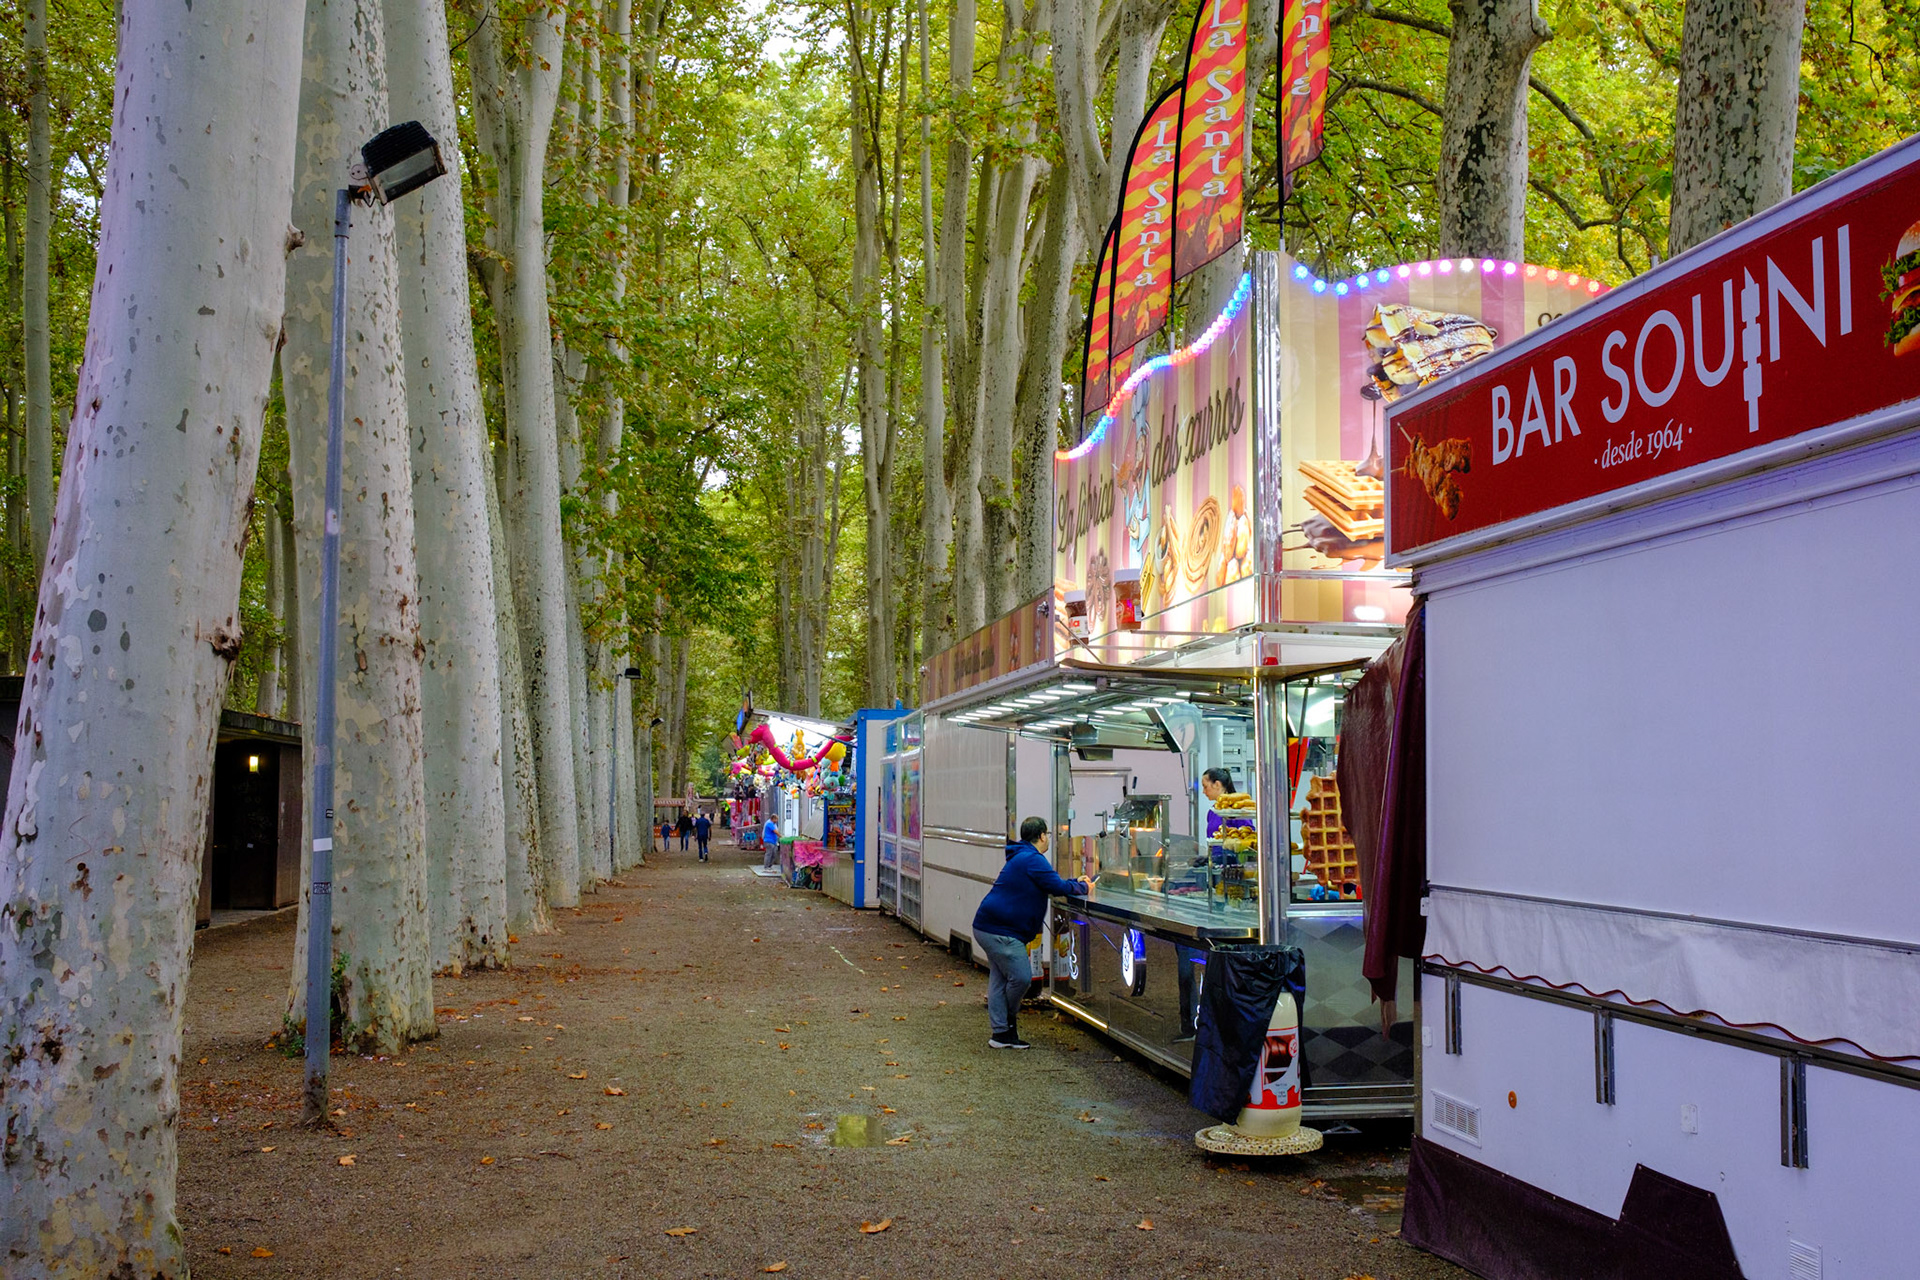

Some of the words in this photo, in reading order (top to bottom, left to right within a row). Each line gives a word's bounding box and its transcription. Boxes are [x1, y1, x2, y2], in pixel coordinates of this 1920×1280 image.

[1209, 0, 1242, 48] La
[1152, 120, 1176, 164] La
[1201, 69, 1232, 197] Santa
[1134, 181, 1168, 287] Santa
[1152, 404, 1182, 488] dels
[1185, 377, 1245, 465] xurros
[1491, 355, 1582, 466] BAR
[1601, 430, 1643, 469] desde
[1646, 418, 1684, 460] 1964
